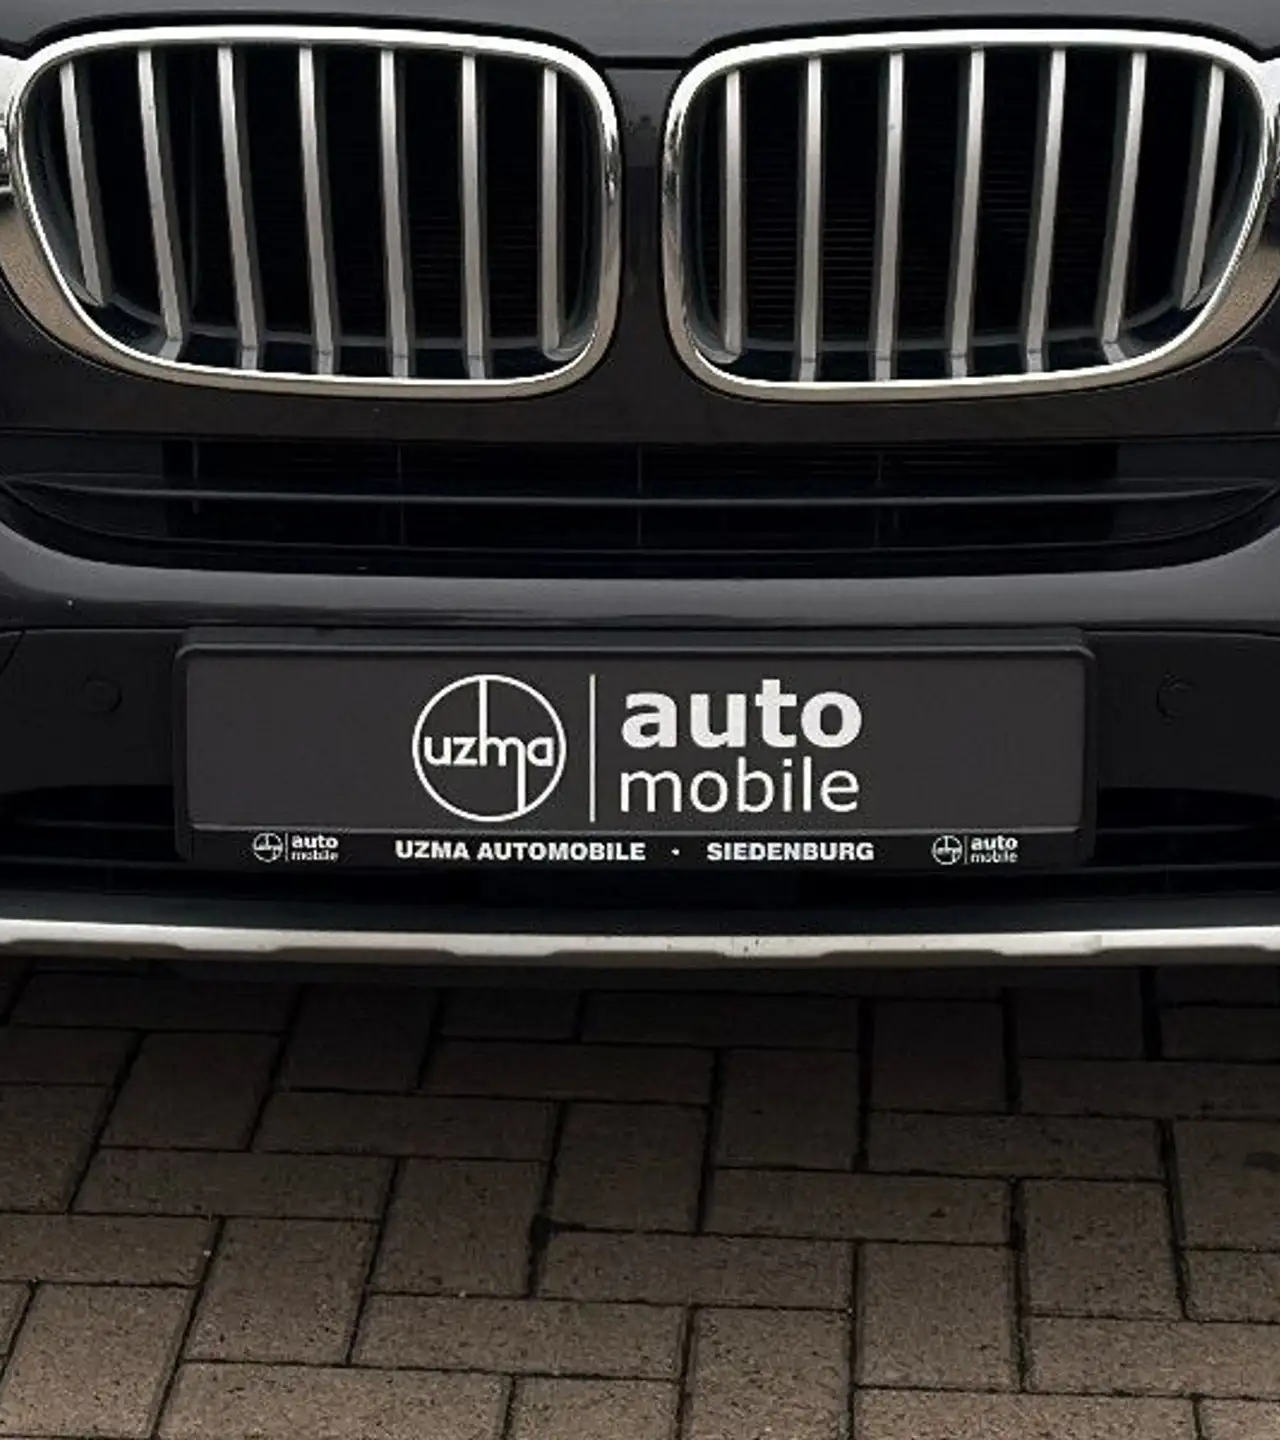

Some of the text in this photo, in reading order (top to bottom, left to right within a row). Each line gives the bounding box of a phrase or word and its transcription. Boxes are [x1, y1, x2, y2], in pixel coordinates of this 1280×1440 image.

[621, 678, 863, 749] auto
[620, 755, 860, 814] mobile
[291, 834, 338, 849] auto
[971, 835, 1018, 850] auto
[291, 850, 338, 862] mobile
[394, 839, 647, 862] UZMA AUTOMOBILE
[706, 842, 876, 862] SIEDENBURG
[971, 851, 1018, 863] mobile
